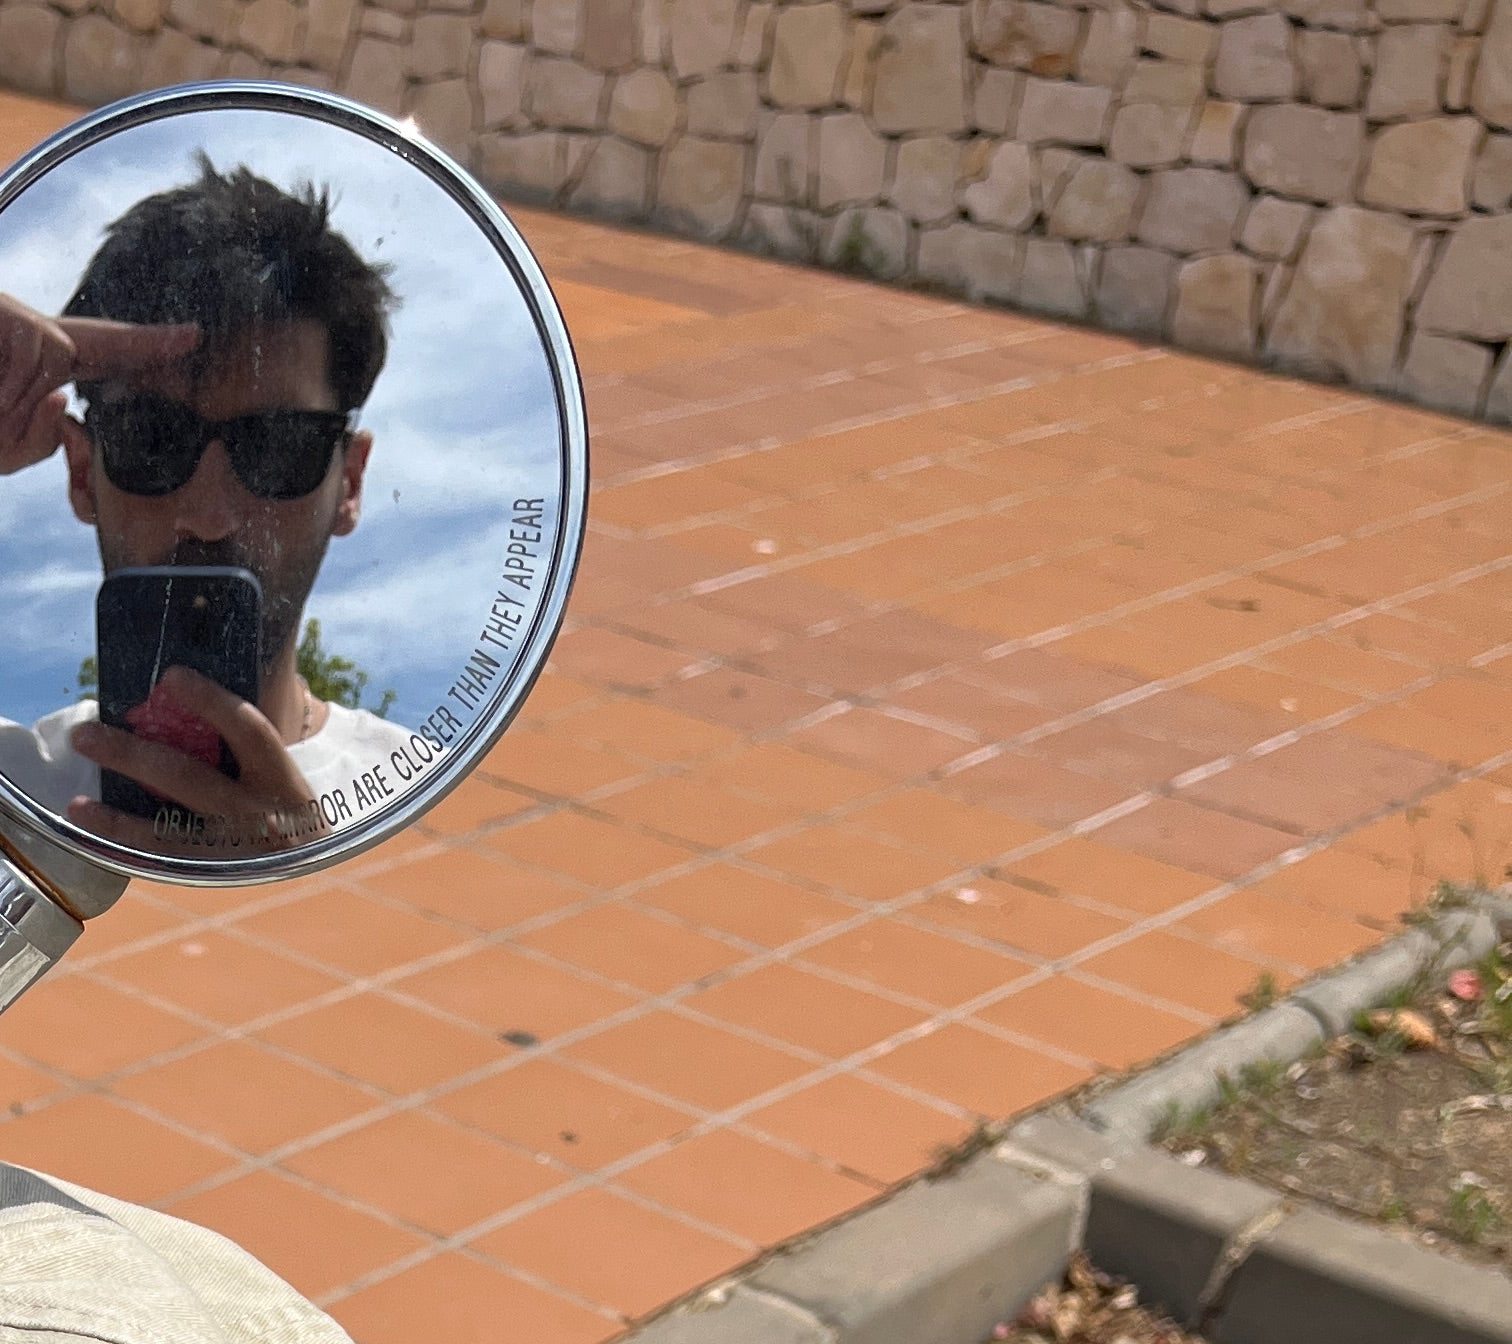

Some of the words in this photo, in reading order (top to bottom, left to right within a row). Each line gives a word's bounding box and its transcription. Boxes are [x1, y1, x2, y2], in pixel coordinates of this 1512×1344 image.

[352, 764, 394, 811] ARE
[390, 704, 463, 782] CLOSER
[448, 648, 501, 711] THAN
[480, 590, 526, 650] THEY
[503, 498, 545, 591] APPEAR
